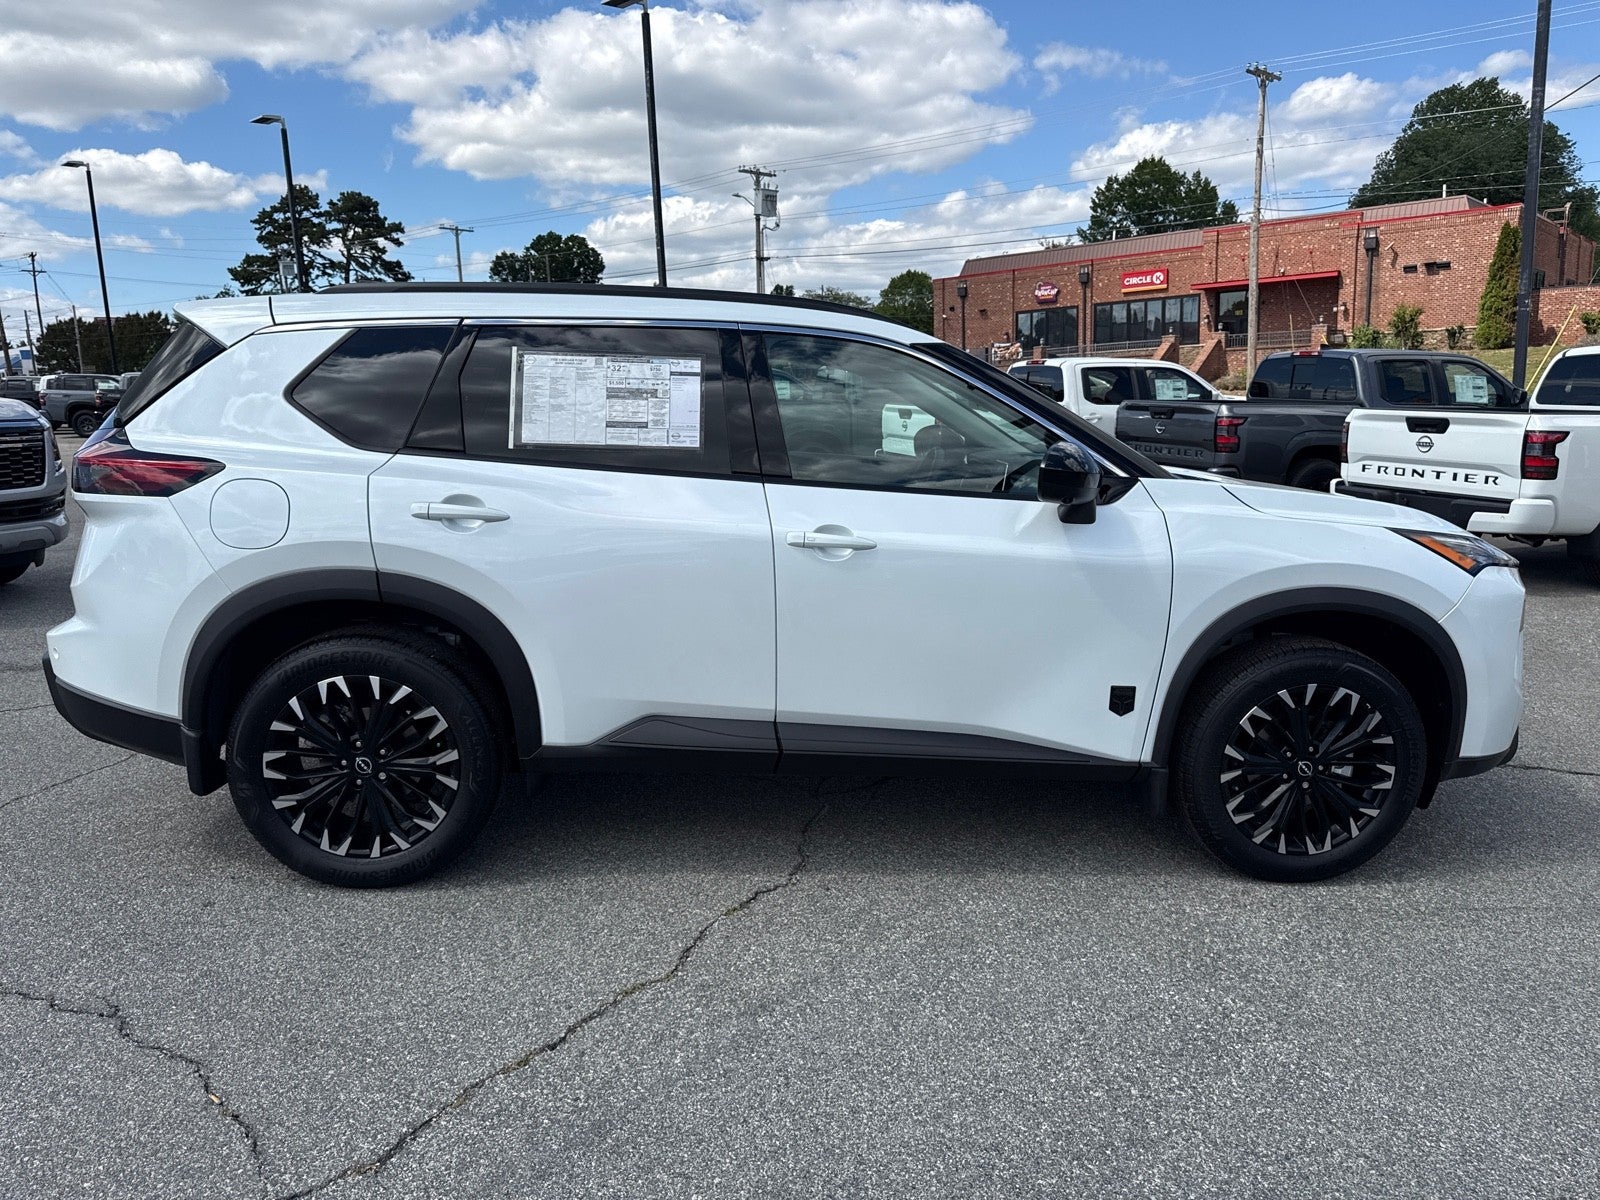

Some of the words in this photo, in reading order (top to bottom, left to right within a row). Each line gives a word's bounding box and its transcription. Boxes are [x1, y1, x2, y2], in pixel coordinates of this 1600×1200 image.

[1124, 275, 1152, 285] CIRCLE
[611, 364, 621, 372] 32
[1361, 464, 1499, 486] FRONTIER
